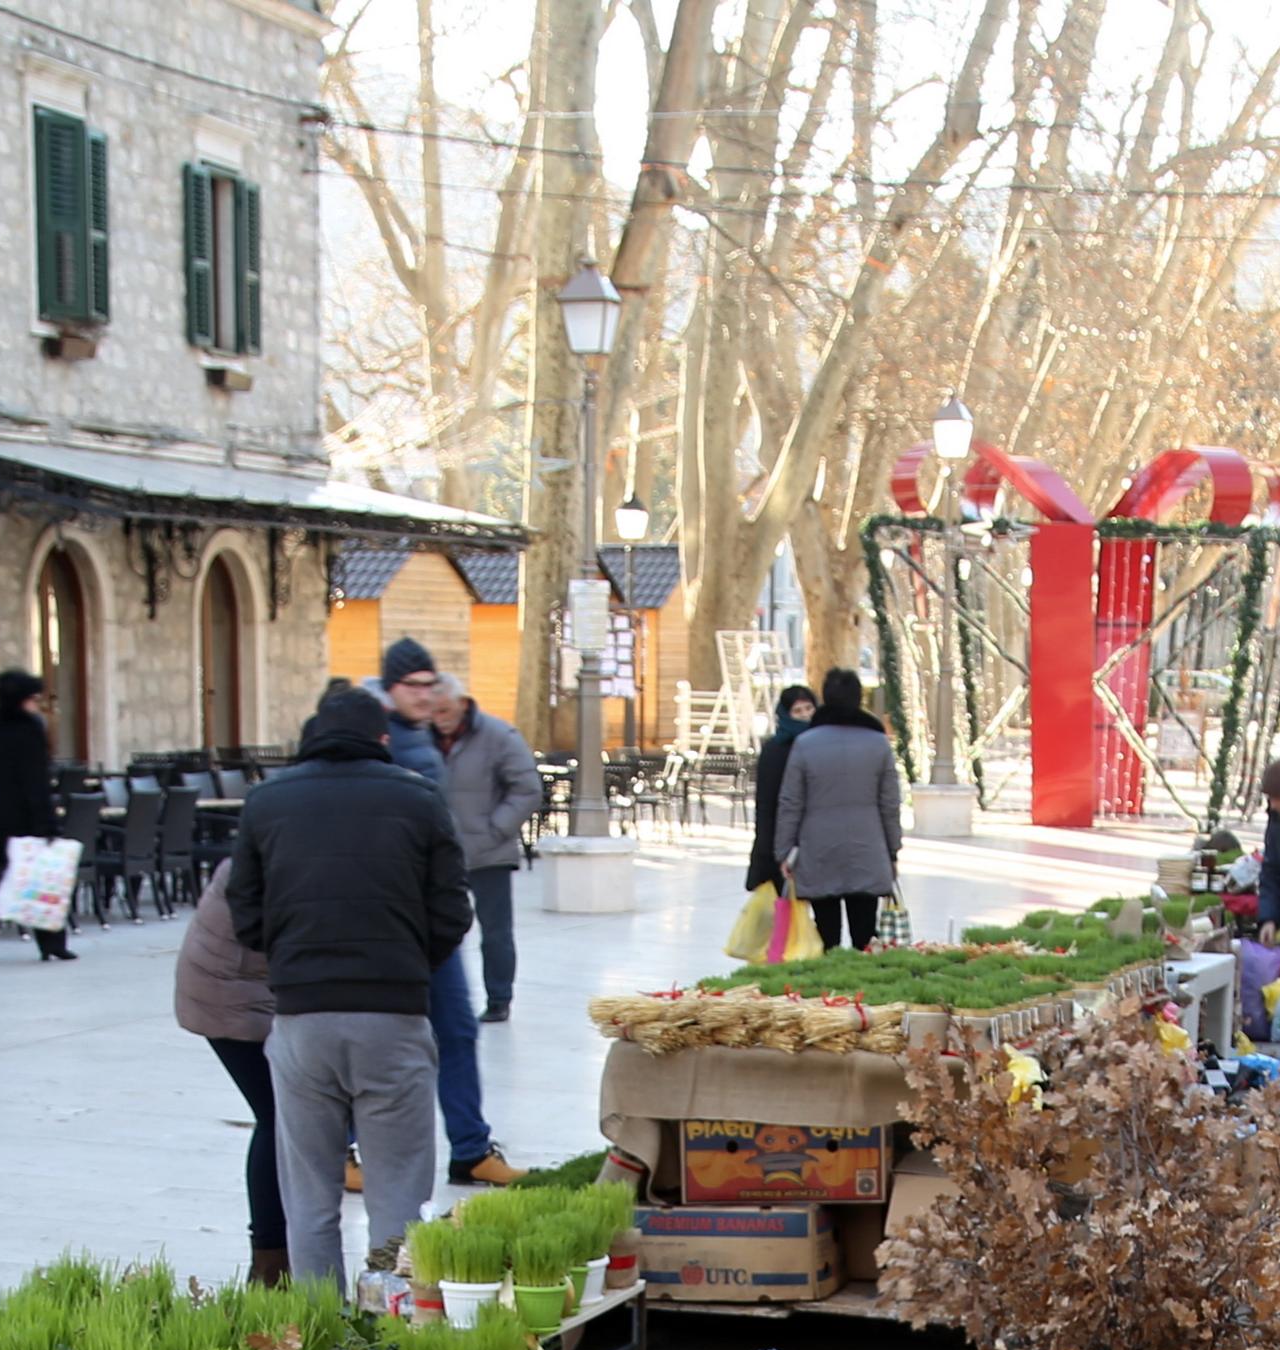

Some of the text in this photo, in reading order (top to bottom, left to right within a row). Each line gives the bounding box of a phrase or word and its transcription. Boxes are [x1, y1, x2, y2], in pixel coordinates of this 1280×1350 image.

[648, 1216, 785, 1233] PREMIUM BANANAS
[705, 1267, 748, 1286] UTC
